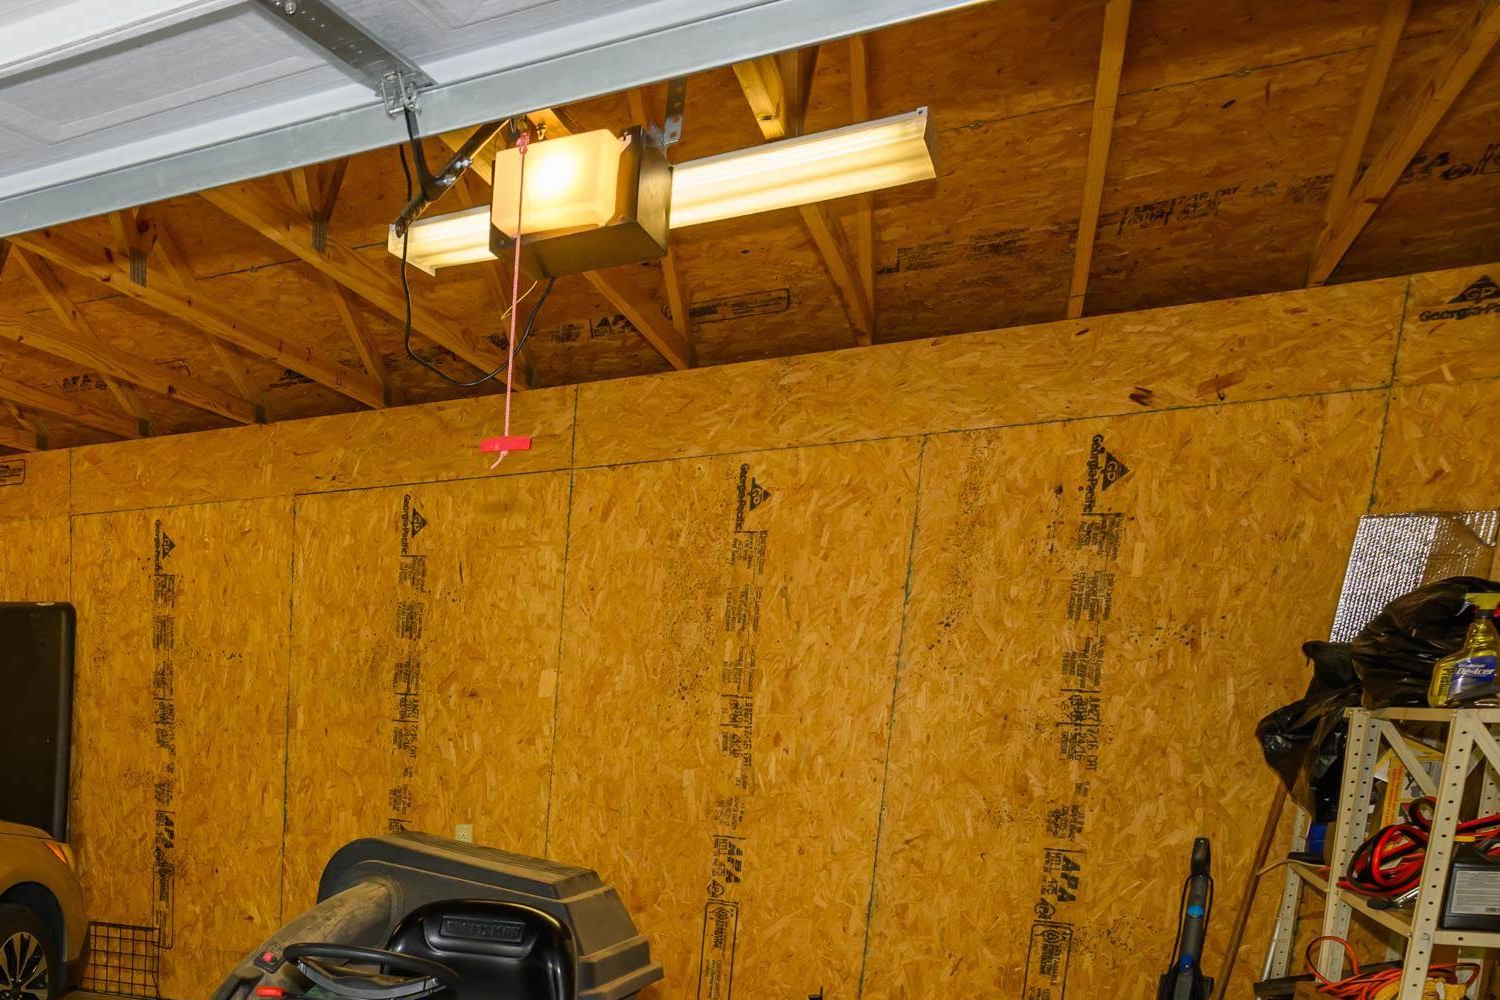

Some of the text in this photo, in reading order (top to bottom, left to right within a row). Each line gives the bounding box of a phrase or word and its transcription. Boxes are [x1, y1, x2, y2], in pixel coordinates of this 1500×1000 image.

[1083, 433, 1105, 513] Georgia-Pacific
[1104, 460, 1117, 482] GP
[401, 494, 412, 554] Georgia-Pacific
[1085, 755, 1098, 772] CAT
[164, 814, 174, 849] APA
[1057, 854, 1081, 902] APA
